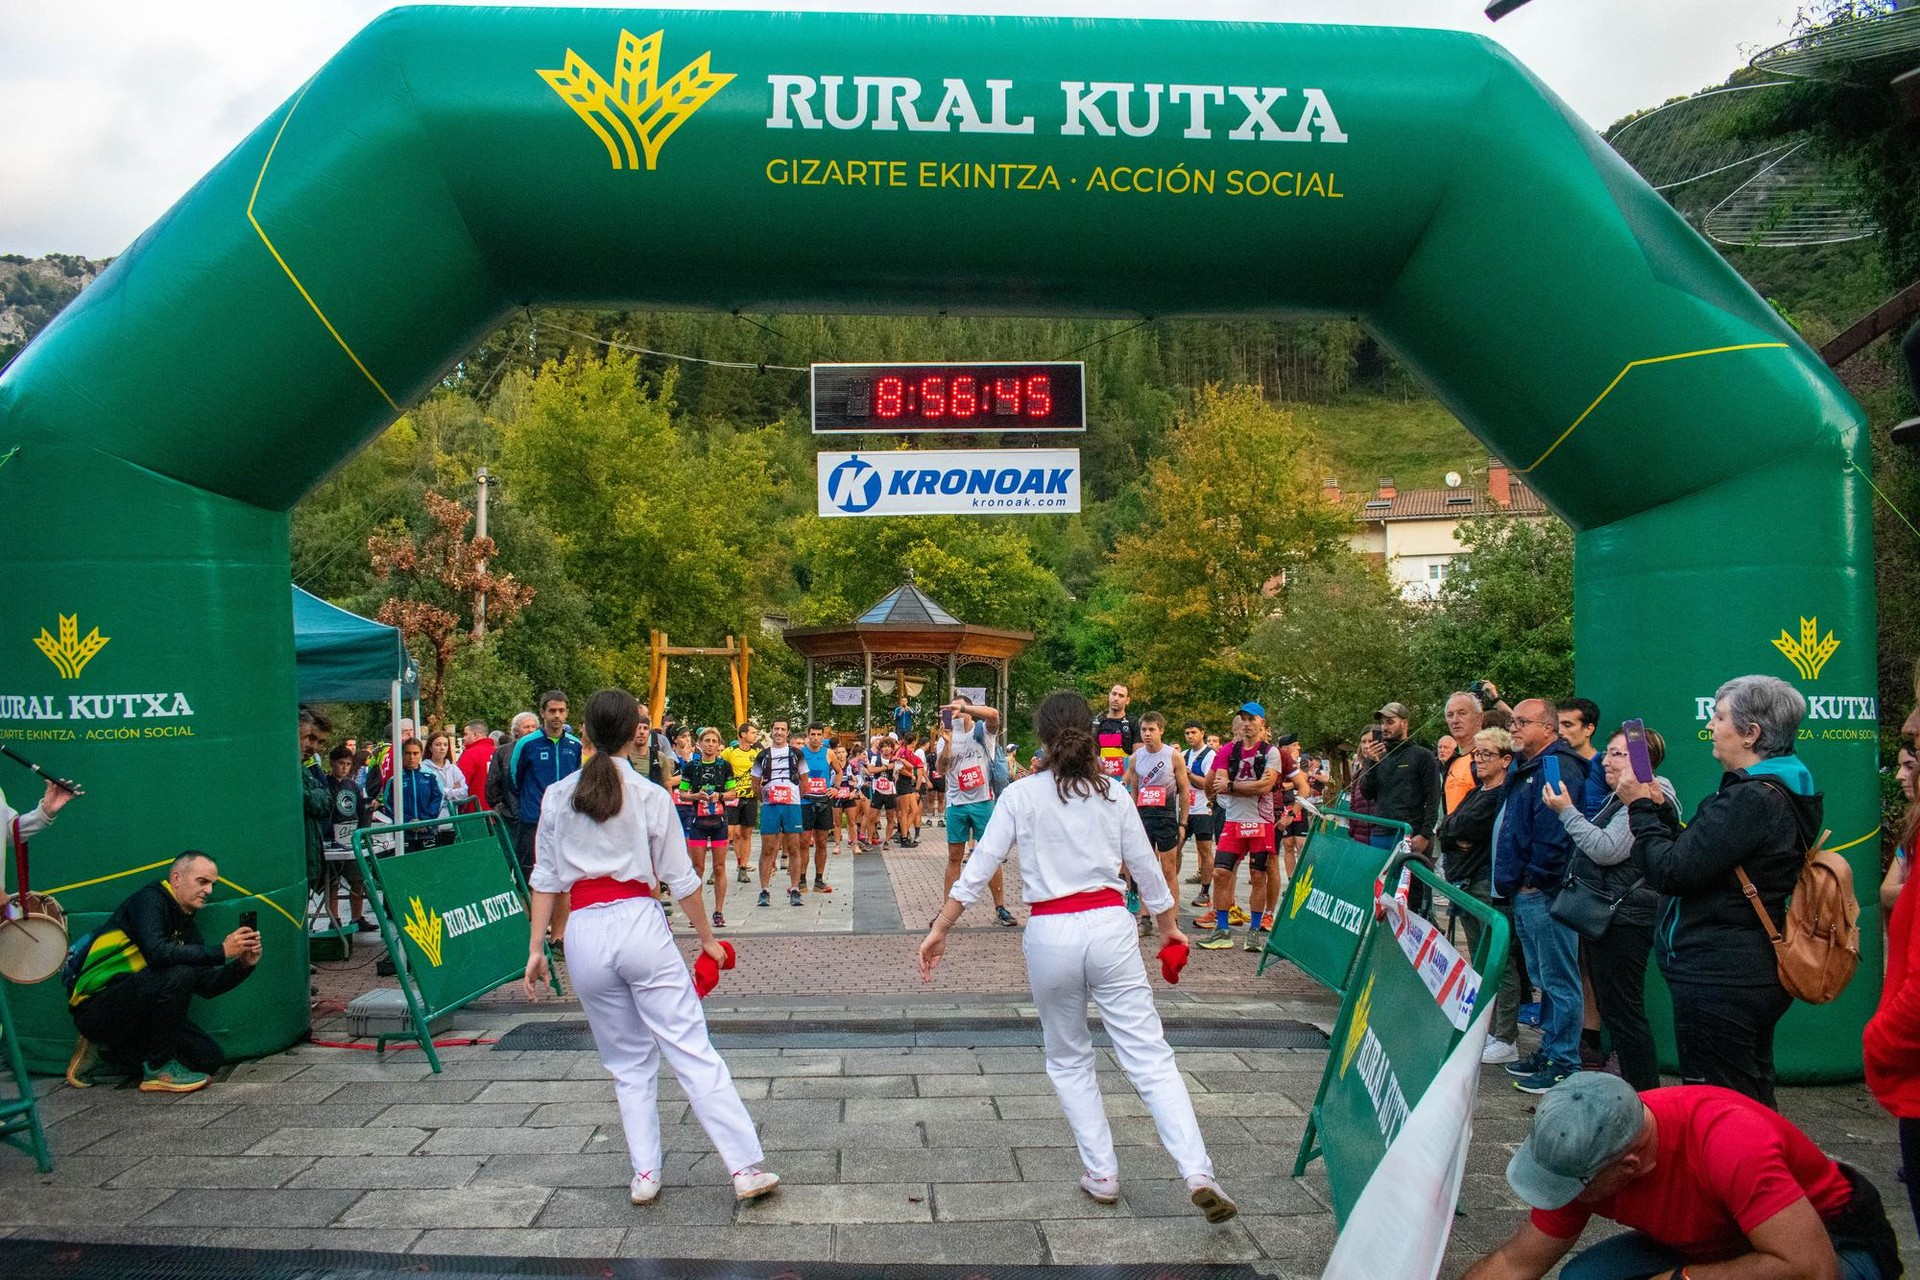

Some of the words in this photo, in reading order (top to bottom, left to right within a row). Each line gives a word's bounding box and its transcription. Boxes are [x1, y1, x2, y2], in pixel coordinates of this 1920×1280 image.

[766, 74, 1034, 134] RURAL
[1060, 81, 1348, 143] KUTXA
[766, 159, 907, 186] GIZARTE
[919, 163, 1060, 191] EKINTZA
[1086, 163, 1214, 194] ACCIÓN
[1226, 170, 1344, 198] SOCIAL
[877, 377, 1051, 418] 8:56:45
[888, 468, 1075, 496] KRONOAK
[972, 497, 1067, 507] kronoak.com
[0, 695, 63, 720] URAL
[69, 692, 194, 719] KUTXA
[1808, 696, 1876, 720] KUTXA
[26, 730, 76, 741] EKINTZA
[86, 726, 140, 740] ACCIÓN
[145, 726, 195, 739] SOCIAL
[1822, 727, 1858, 740] ACCIÓN
[962, 771, 978, 781] 285
[1104, 760, 1119, 768] 284
[1143, 790, 1160, 798] 256
[442, 903, 487, 938] RURAL
[481, 890, 523, 923] KUTXA
[1306, 888, 1334, 919] RURAL
[1330, 898, 1365, 935] KUTXA
[1357, 1025, 1390, 1114] RURAL
[1378, 1070, 1411, 1149] KUT
